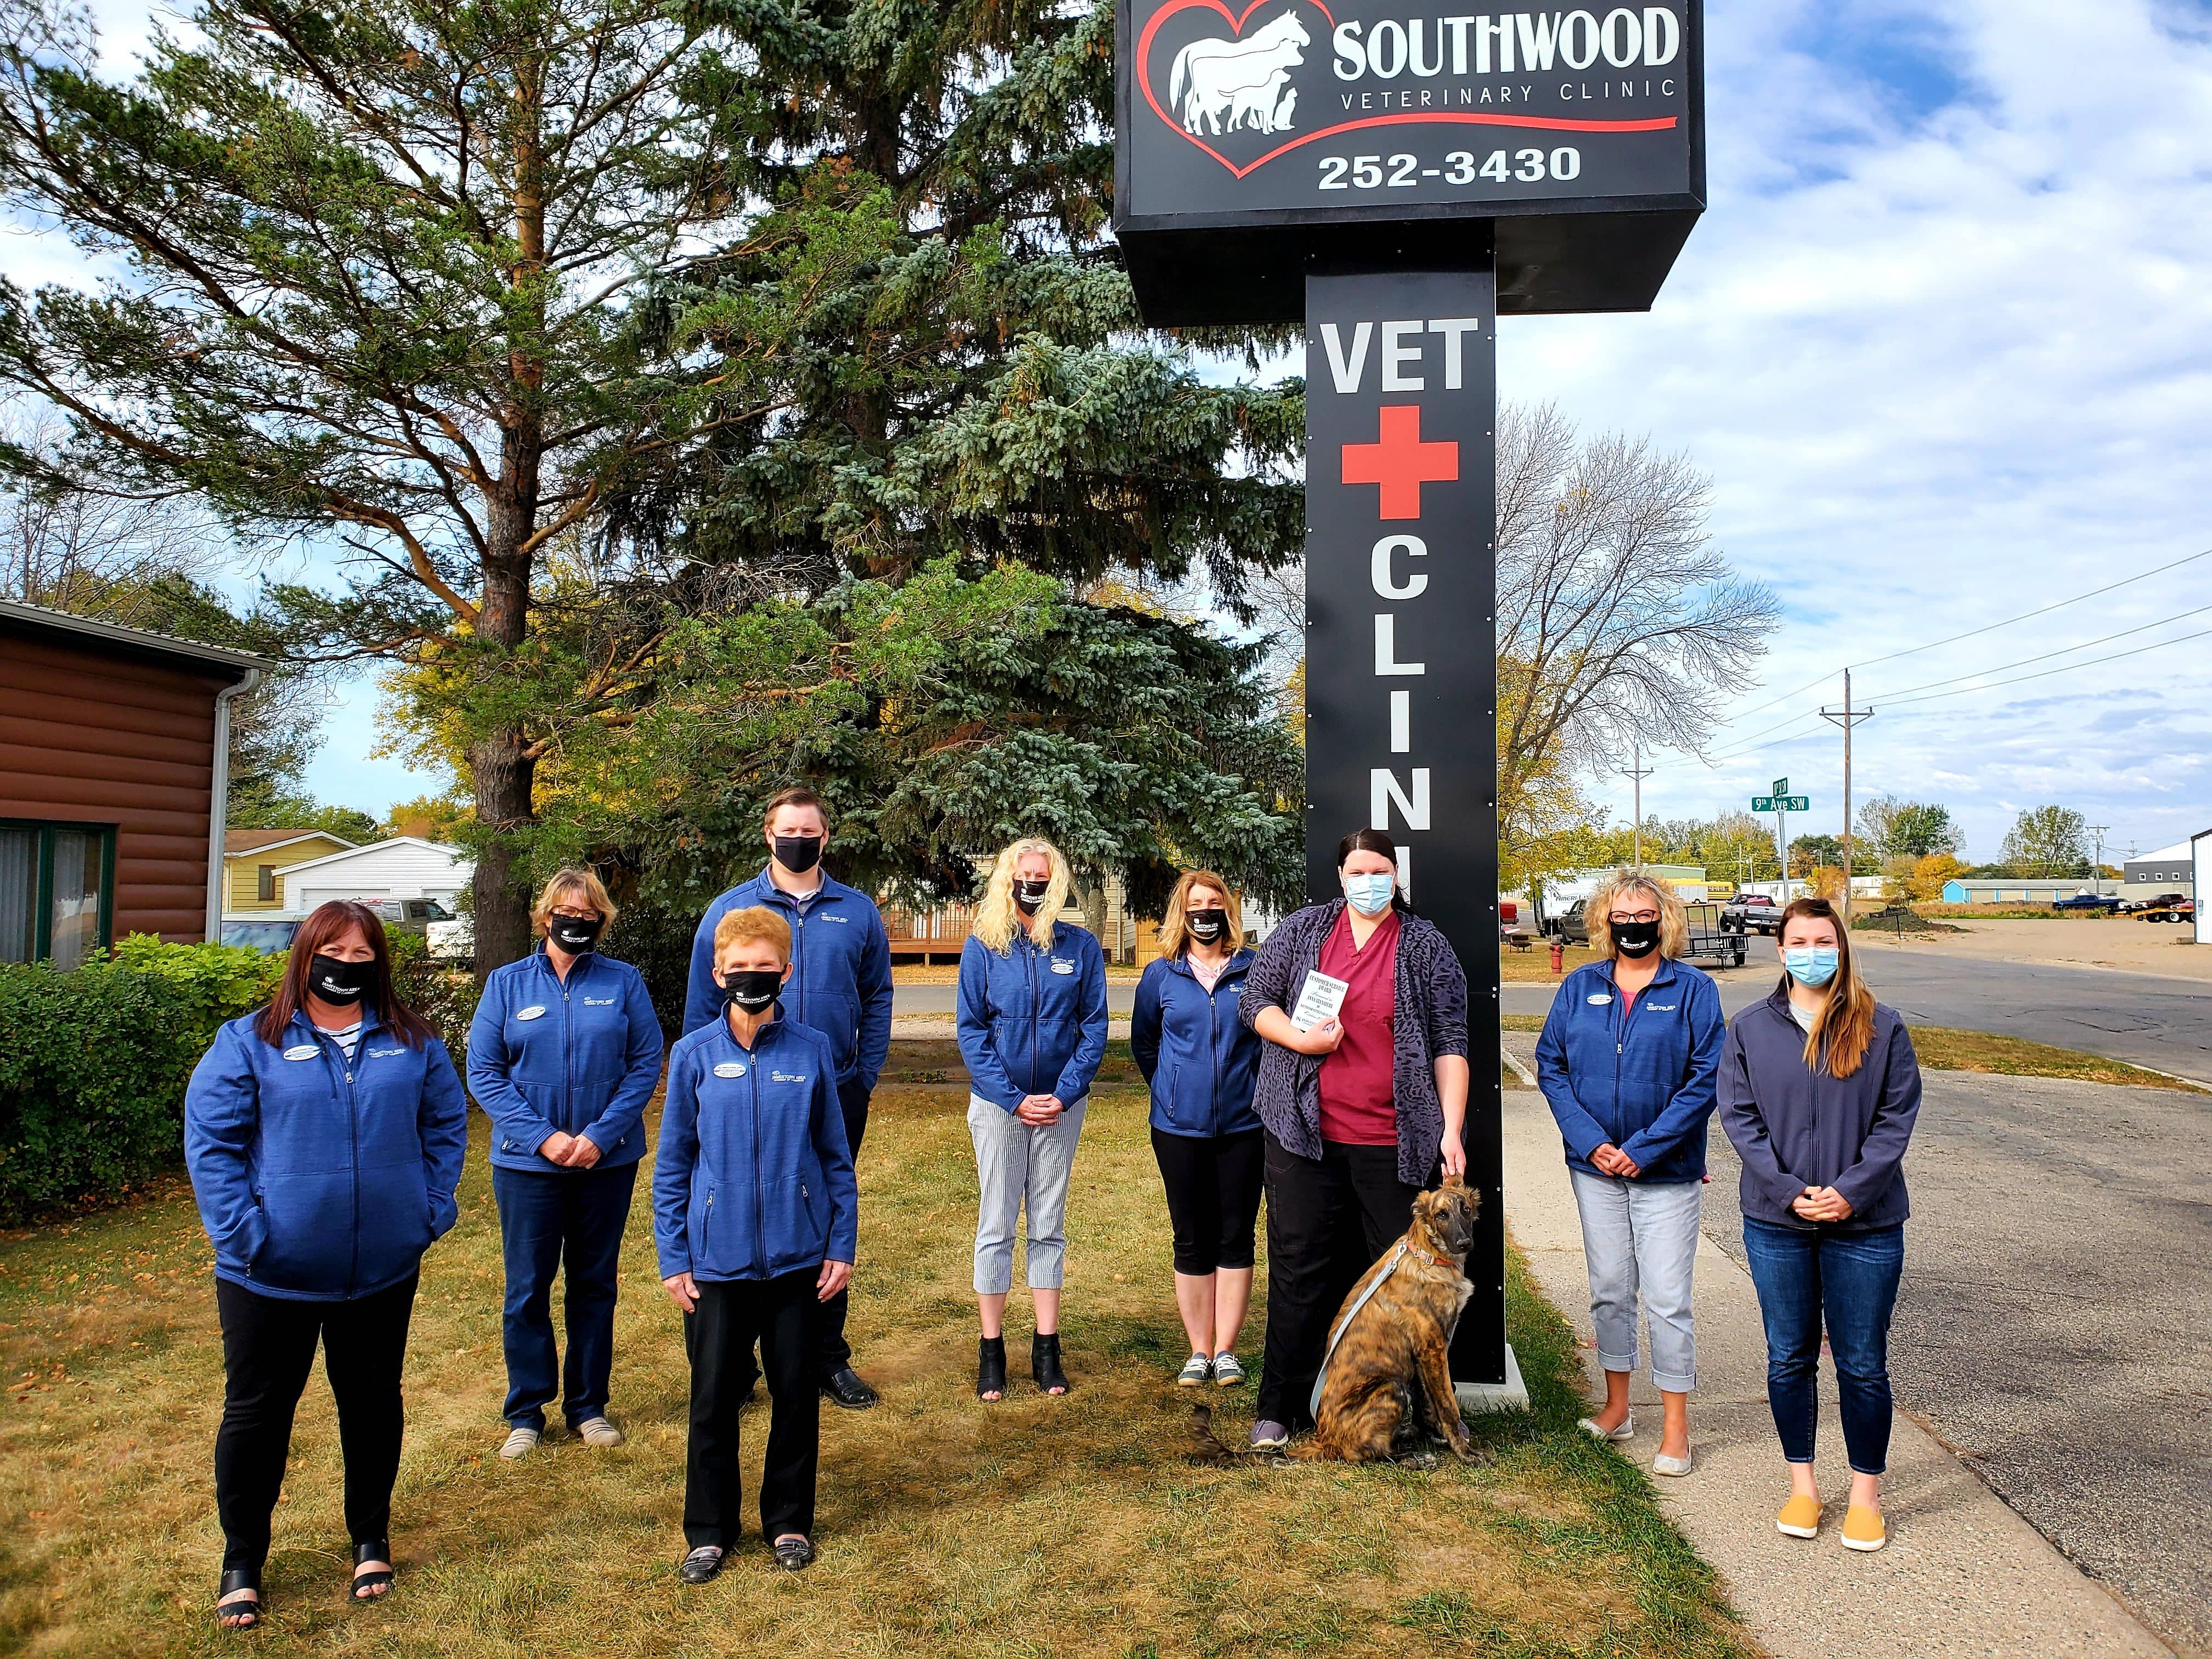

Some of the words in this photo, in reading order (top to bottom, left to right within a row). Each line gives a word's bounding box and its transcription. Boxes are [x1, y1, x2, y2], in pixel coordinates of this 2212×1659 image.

[1333, 7, 1680, 81] SOUTHWOOD
[1341, 85, 1532, 110] VETERINARY
[1560, 79, 1674, 100] CLINIC
[1318, 147, 1581, 190] 252-3430
[1319, 318, 1479, 394] VET
[1370, 534, 1430, 906] CLINI
[1756, 798, 1767, 810] 9th
[1770, 798, 1788, 810] Ave
[1791, 797, 1805, 810] SW
[322, 981, 349, 992] JAMESTOWN
